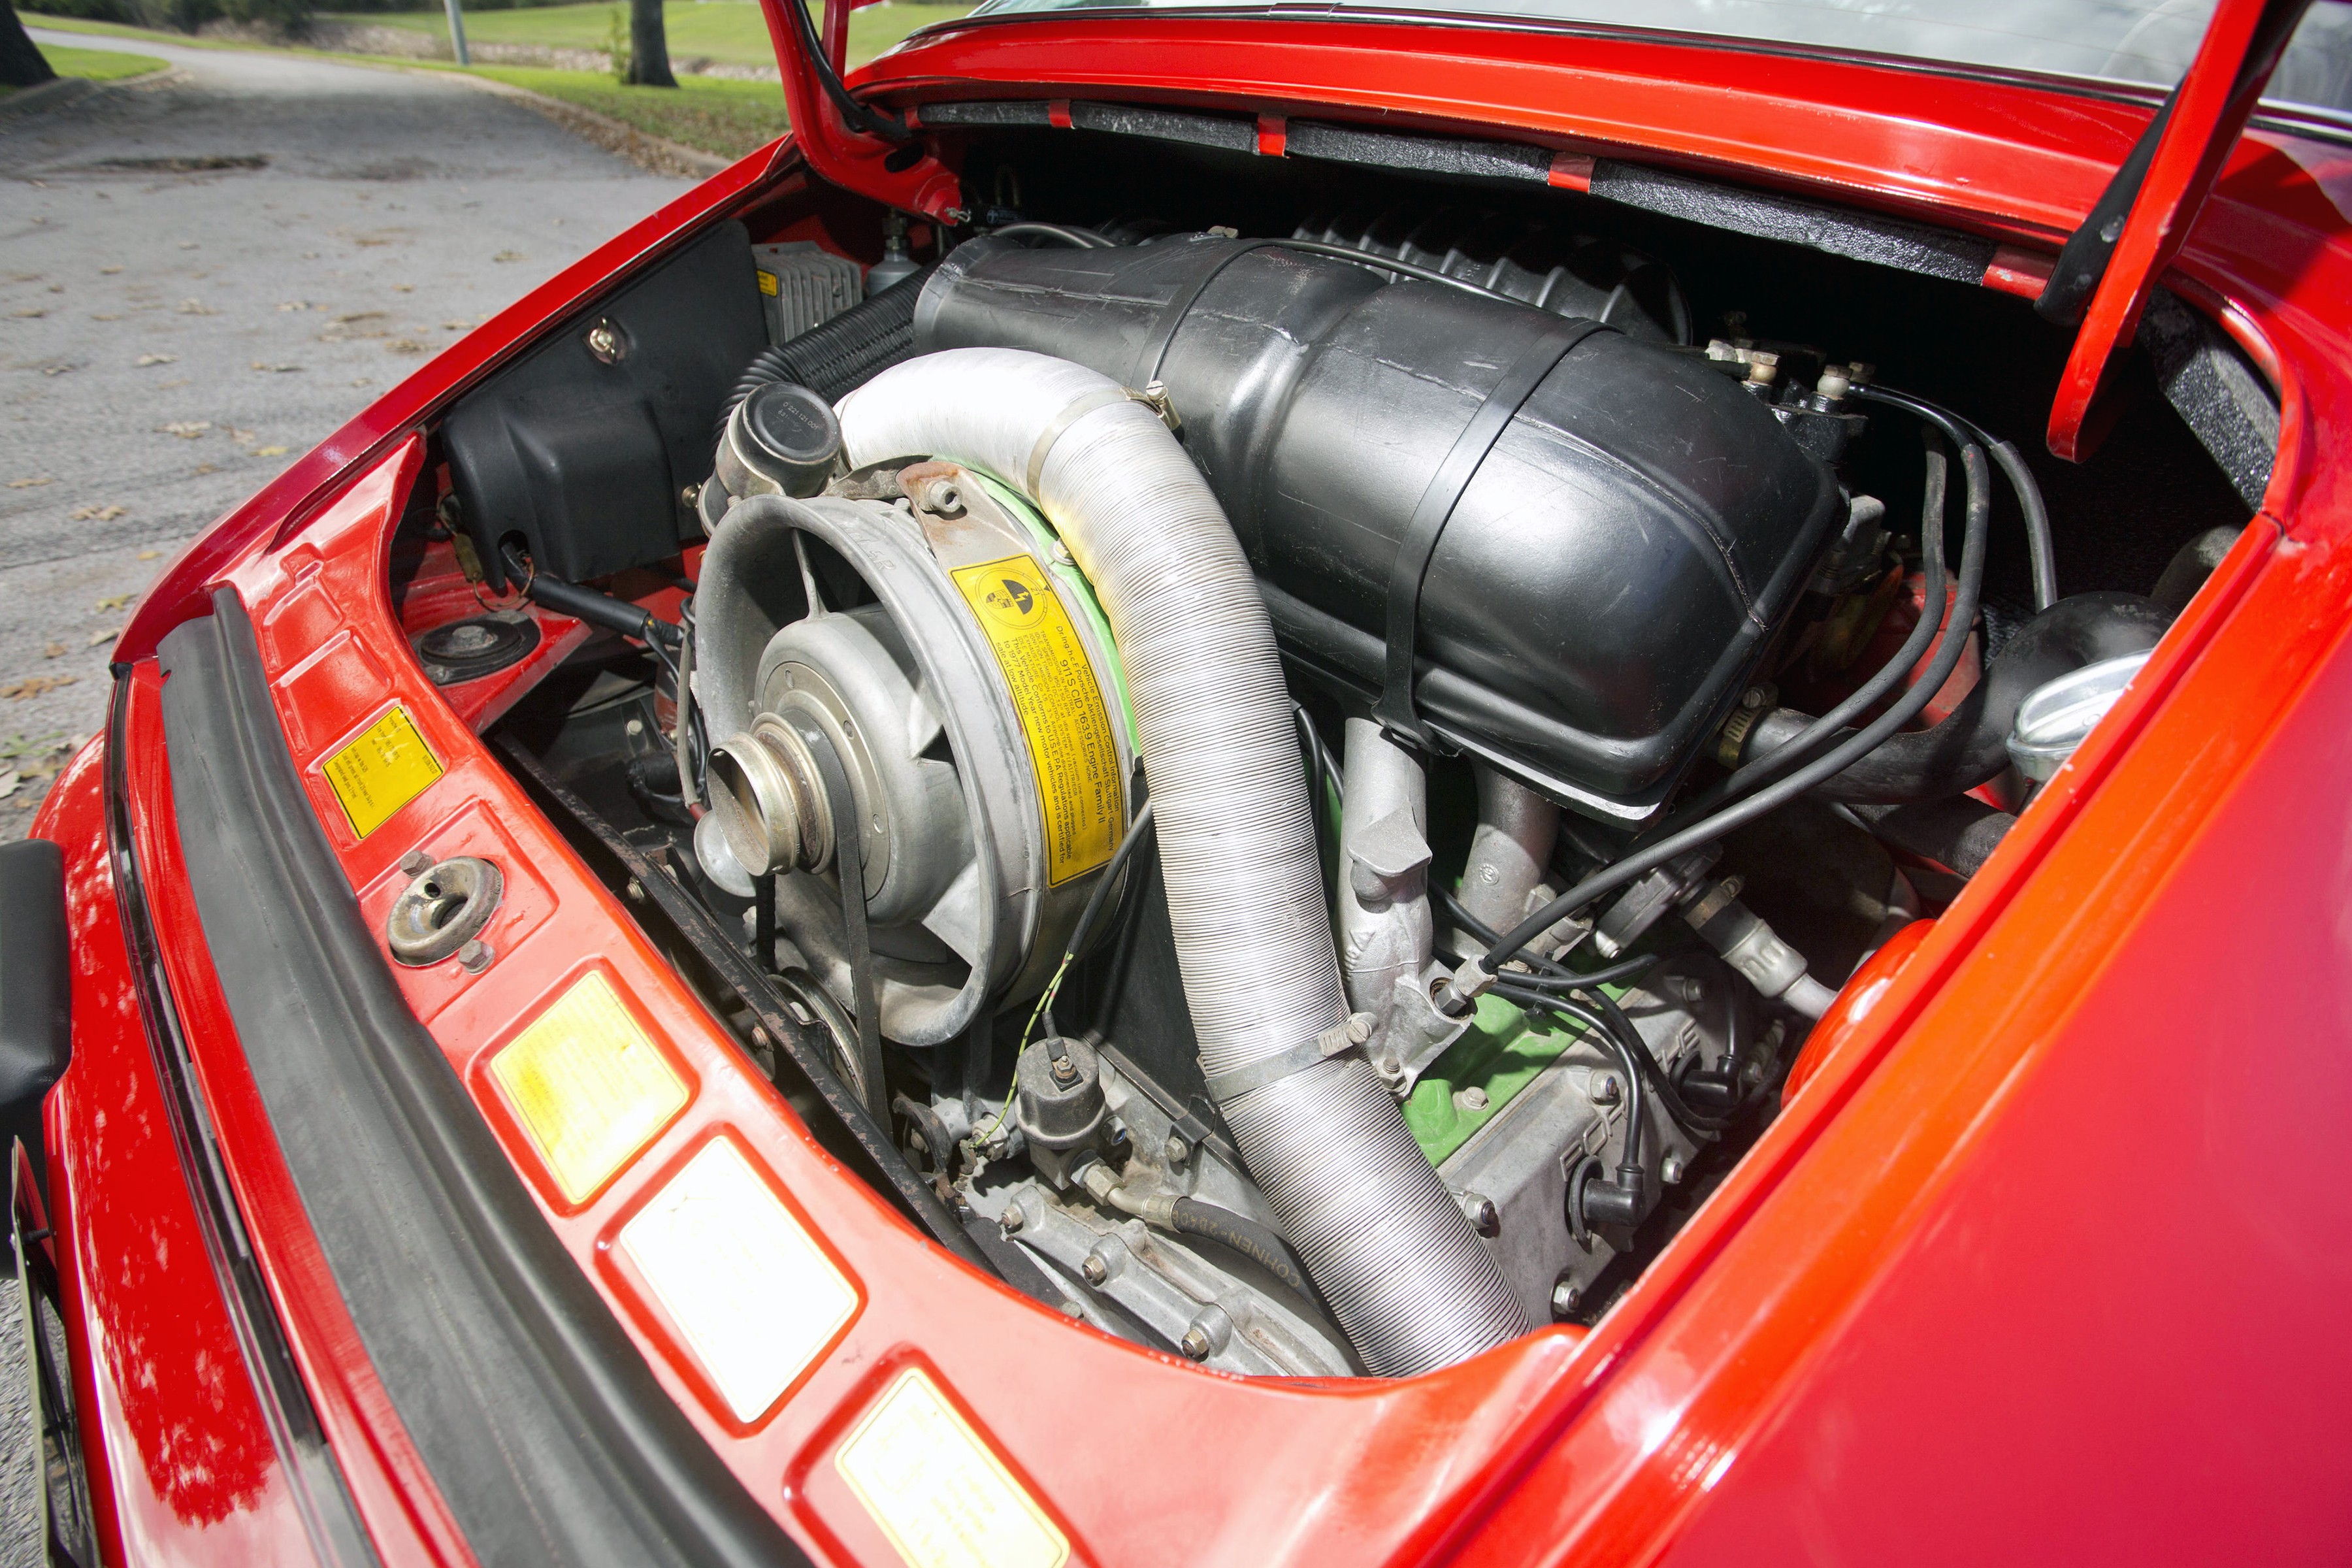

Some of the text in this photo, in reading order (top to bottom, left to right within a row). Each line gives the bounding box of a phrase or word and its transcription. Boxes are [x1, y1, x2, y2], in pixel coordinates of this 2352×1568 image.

[787, 404, 799, 415] 221
[798, 412, 808, 422] 121
[807, 419, 818, 430] 001
[1034, 631, 1043, 644] IDLE
[1040, 630, 1062, 675] TRANSMISSION
[995, 642, 1007, 658] sale
[1007, 668, 1017, 683] low
[1022, 634, 1039, 661] EXHAUST
[1036, 662, 1051, 692] EMISSION
[1047, 693, 1060, 722] CONTROL
[1059, 659, 1072, 677] 911
[1066, 678, 1076, 687] S
[1029, 632, 1043, 659] IGNITION
[1065, 732, 1075, 751] speed
[1070, 688, 1084, 709] CID
[1007, 649, 1021, 668] 1977
[1017, 670, 1031, 695] Model
[1027, 696, 1037, 715] Year
[1034, 715, 1043, 733] new
[1039, 734, 1050, 759] motor
[1045, 760, 1058, 793] vehicles
[1017, 636, 1026, 649] IDLE
[1060, 759, 1072, 798] disconnected
[1075, 669, 1091, 702] Porsche
[1086, 702, 1109, 778] Aktiengesellschaft
[1081, 664, 1120, 811] Vehicle Emission Control Information
[1011, 638, 1022, 655] This
[1019, 655, 1035, 683] Vehicle
[1031, 683, 1049, 724] Conforms
[1044, 725, 1051, 734] to
[1056, 772, 1069, 820] Regulations
[1064, 821, 1073, 860] applicable
[1086, 742, 1100, 779] Engine
[1094, 781, 1103, 815] Family
